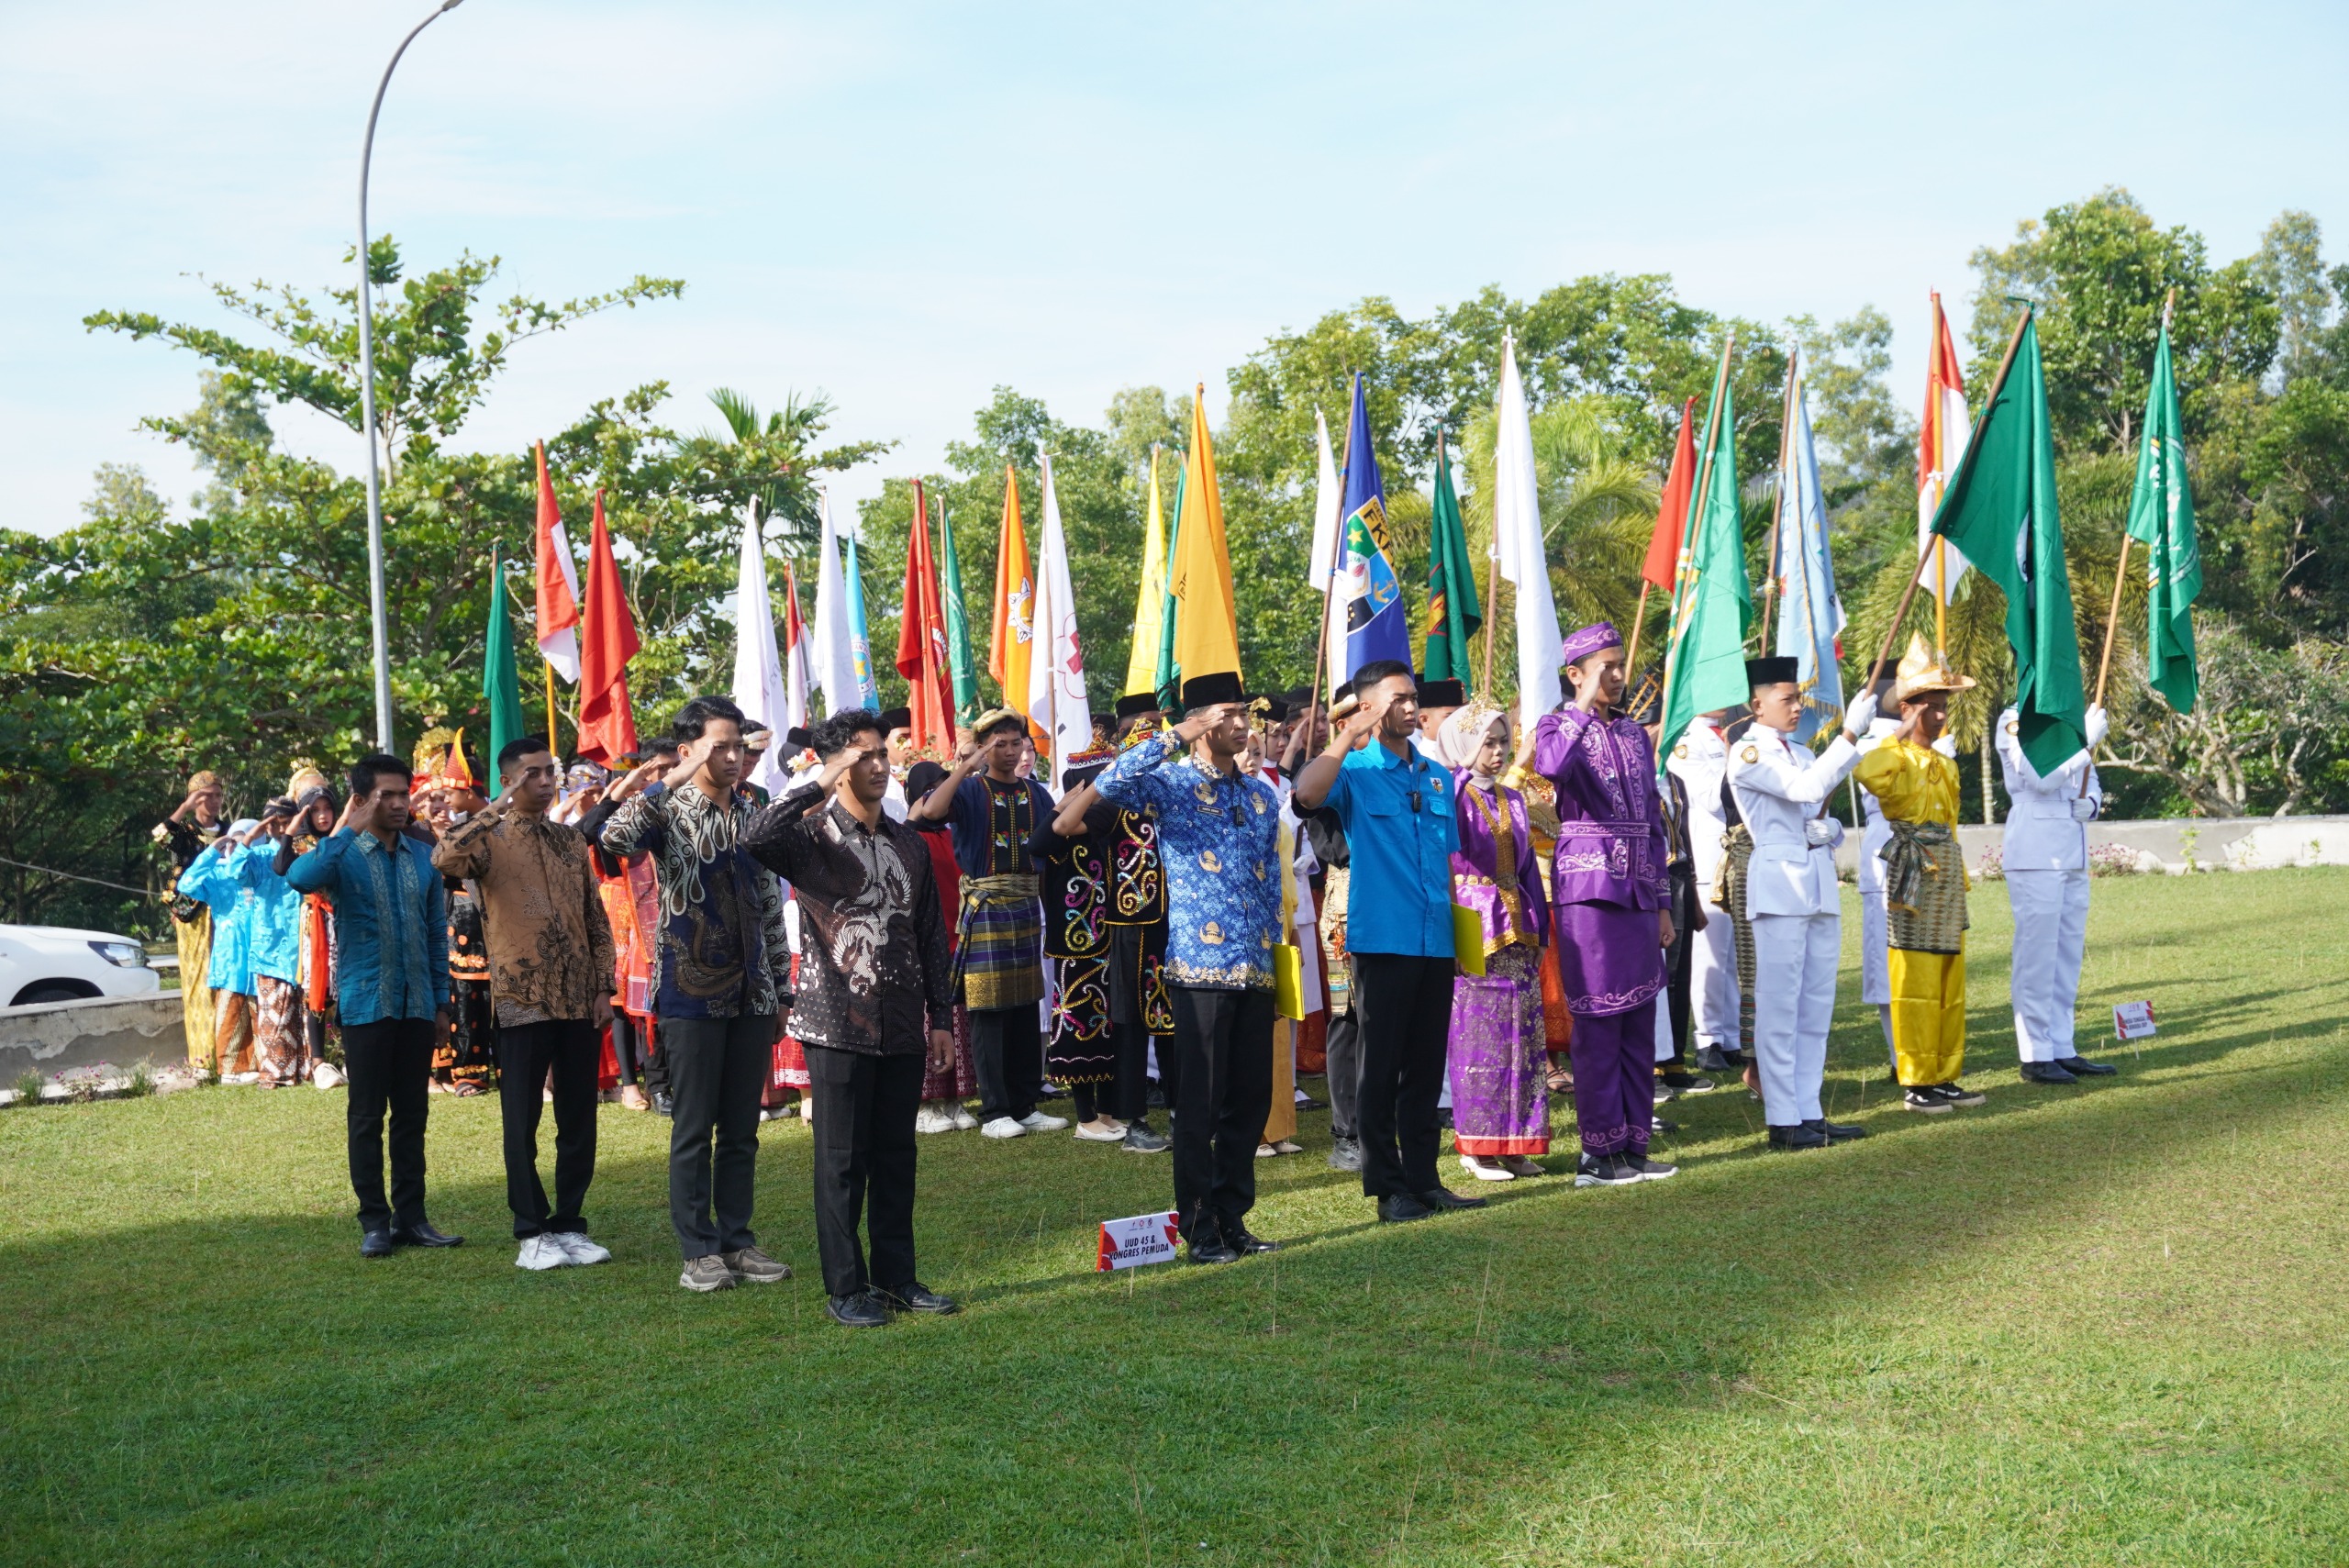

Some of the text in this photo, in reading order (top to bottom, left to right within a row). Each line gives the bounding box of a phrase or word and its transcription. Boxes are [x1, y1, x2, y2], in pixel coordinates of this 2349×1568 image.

[1125, 1235, 1155, 1248] UUD 45 &
[1108, 1243, 1169, 1261] KONGRES PEMUDA
